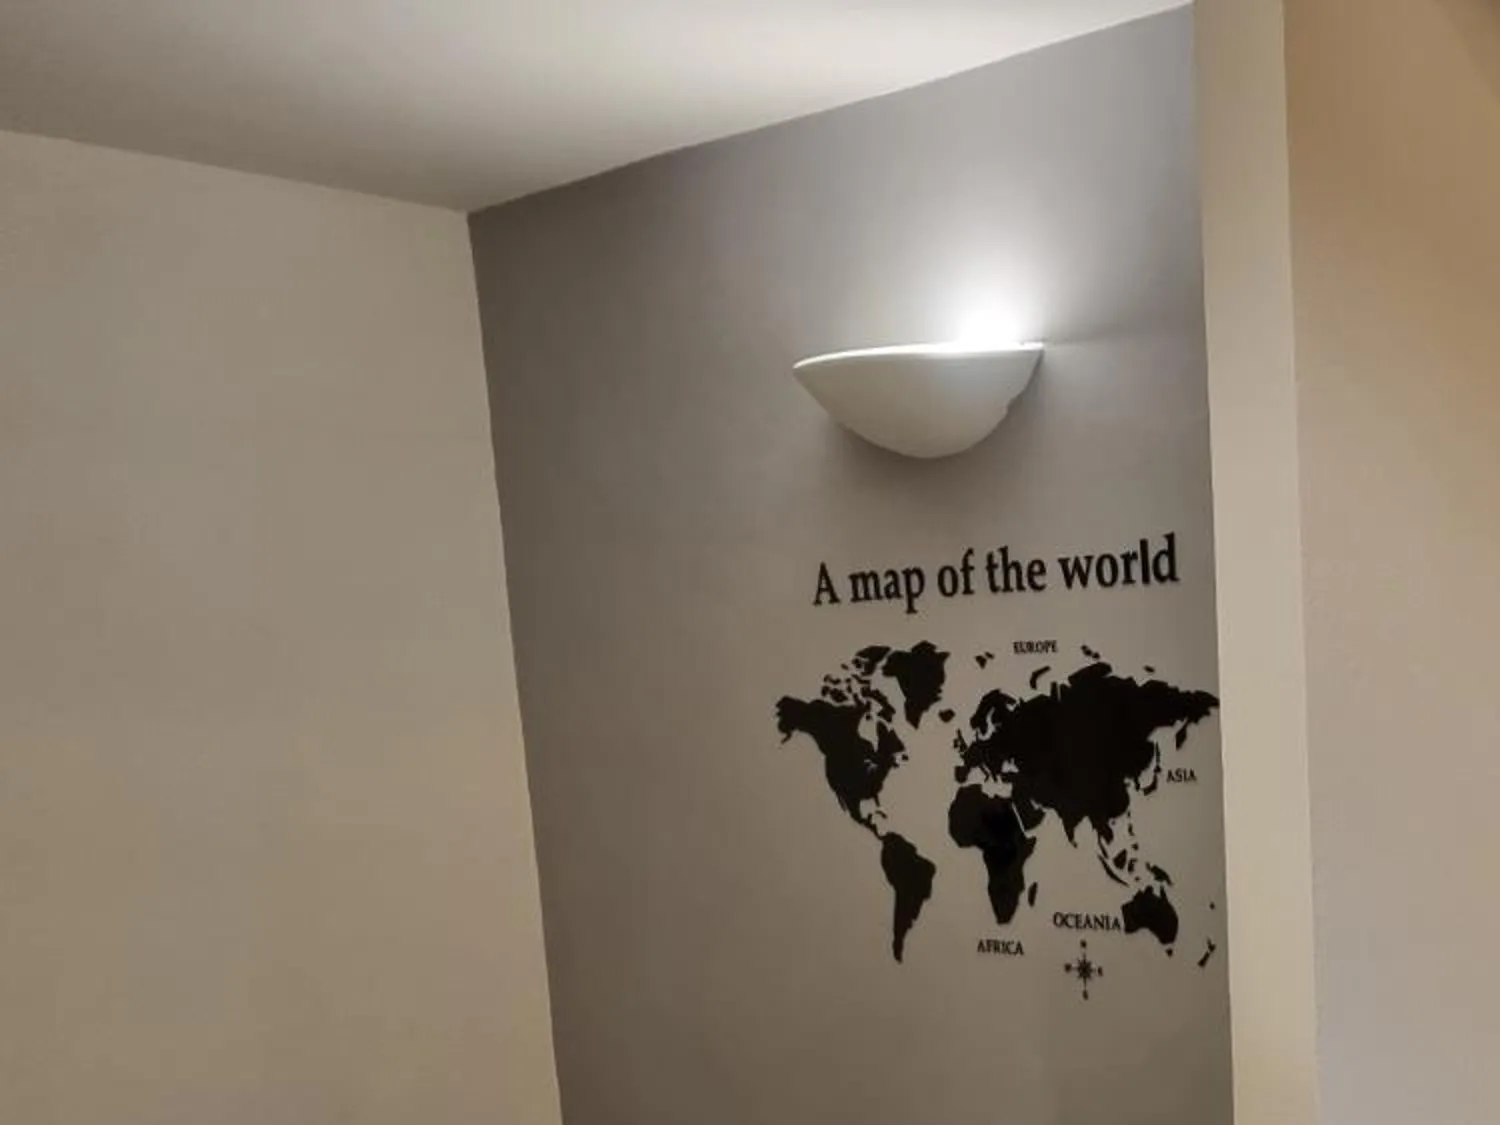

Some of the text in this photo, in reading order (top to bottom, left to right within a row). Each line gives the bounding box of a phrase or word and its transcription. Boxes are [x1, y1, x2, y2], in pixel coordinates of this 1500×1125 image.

[813, 531, 1180, 615] A map of the world
[1012, 639, 1057, 655] EUROPE
[1166, 767, 1197, 783] ASIA
[1052, 911, 1120, 932] OCEANIA
[977, 938, 1025, 956] AFRICA
